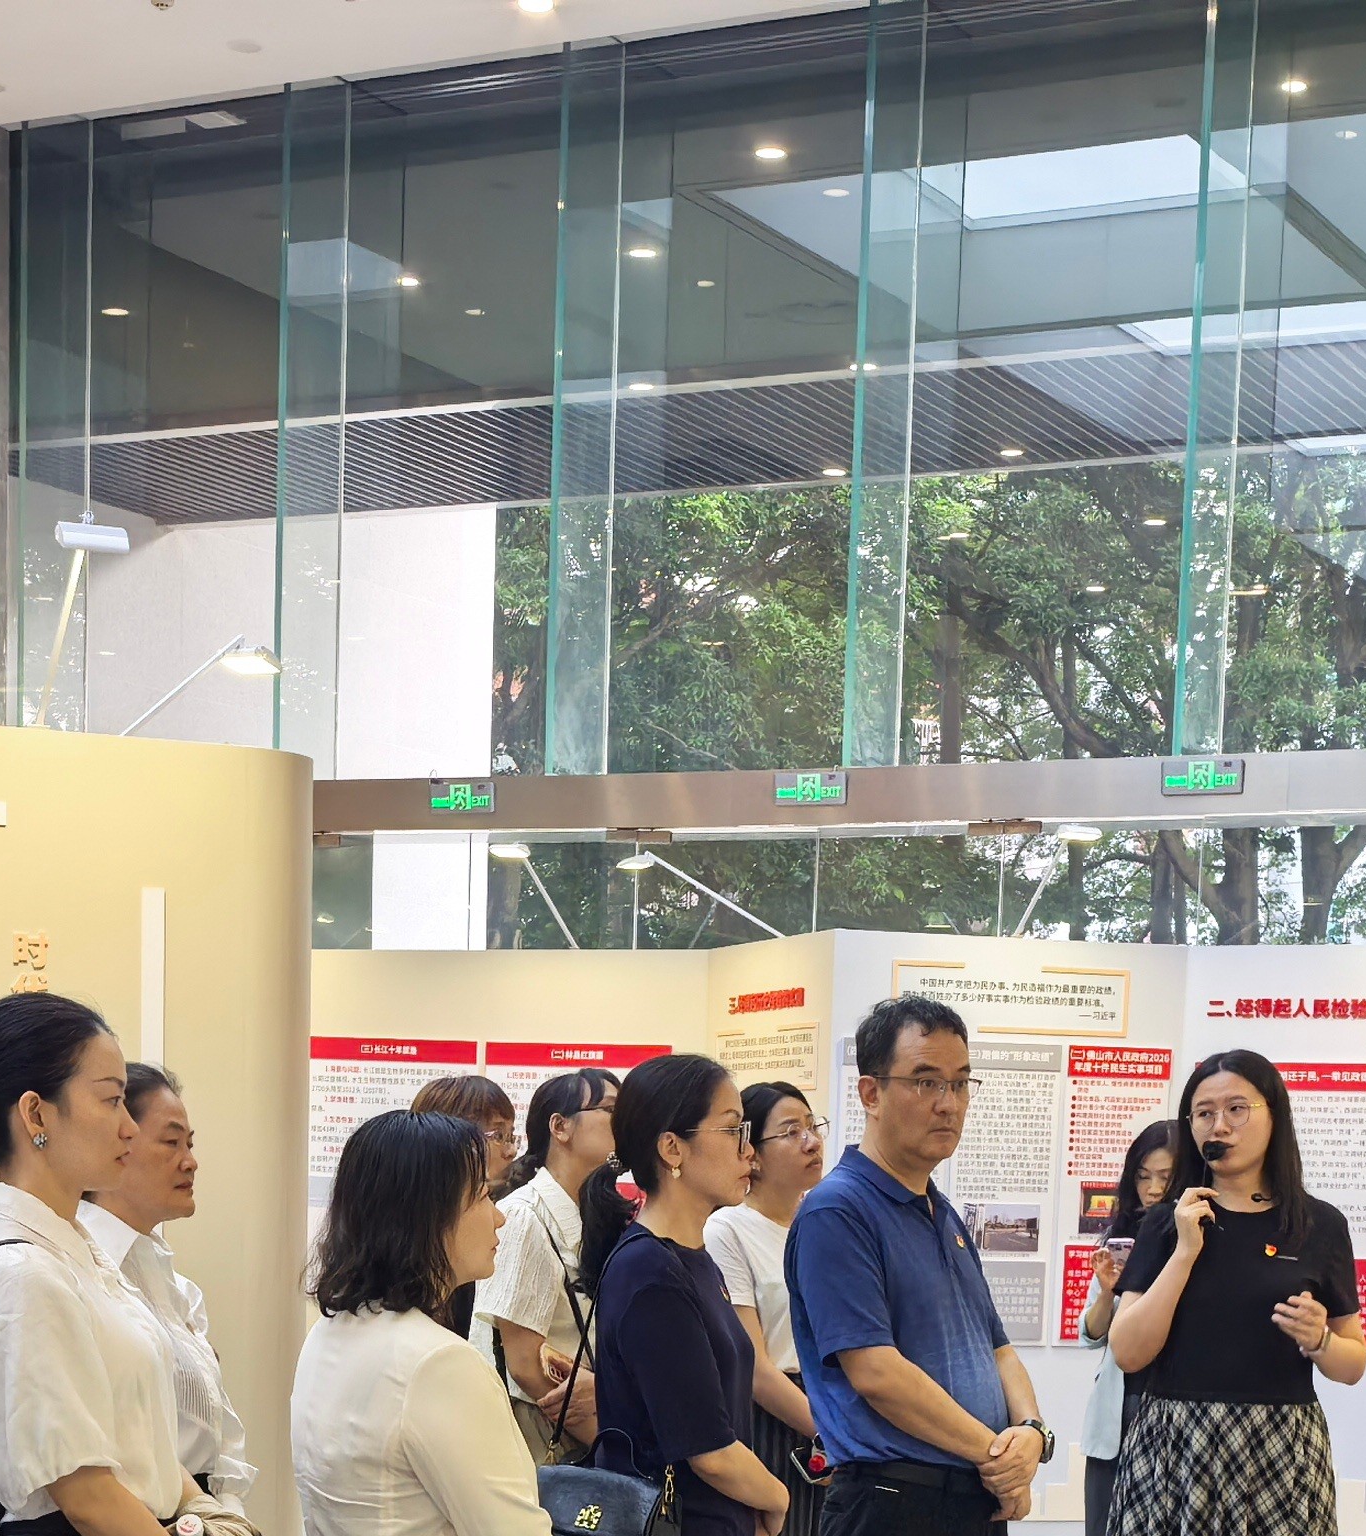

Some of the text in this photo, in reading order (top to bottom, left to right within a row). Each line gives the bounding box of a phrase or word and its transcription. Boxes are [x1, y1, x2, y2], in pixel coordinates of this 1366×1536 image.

[1215, 773, 1238, 786] EXIT
[820, 786, 842, 798] EXIT
[472, 795, 490, 806] EXIT
